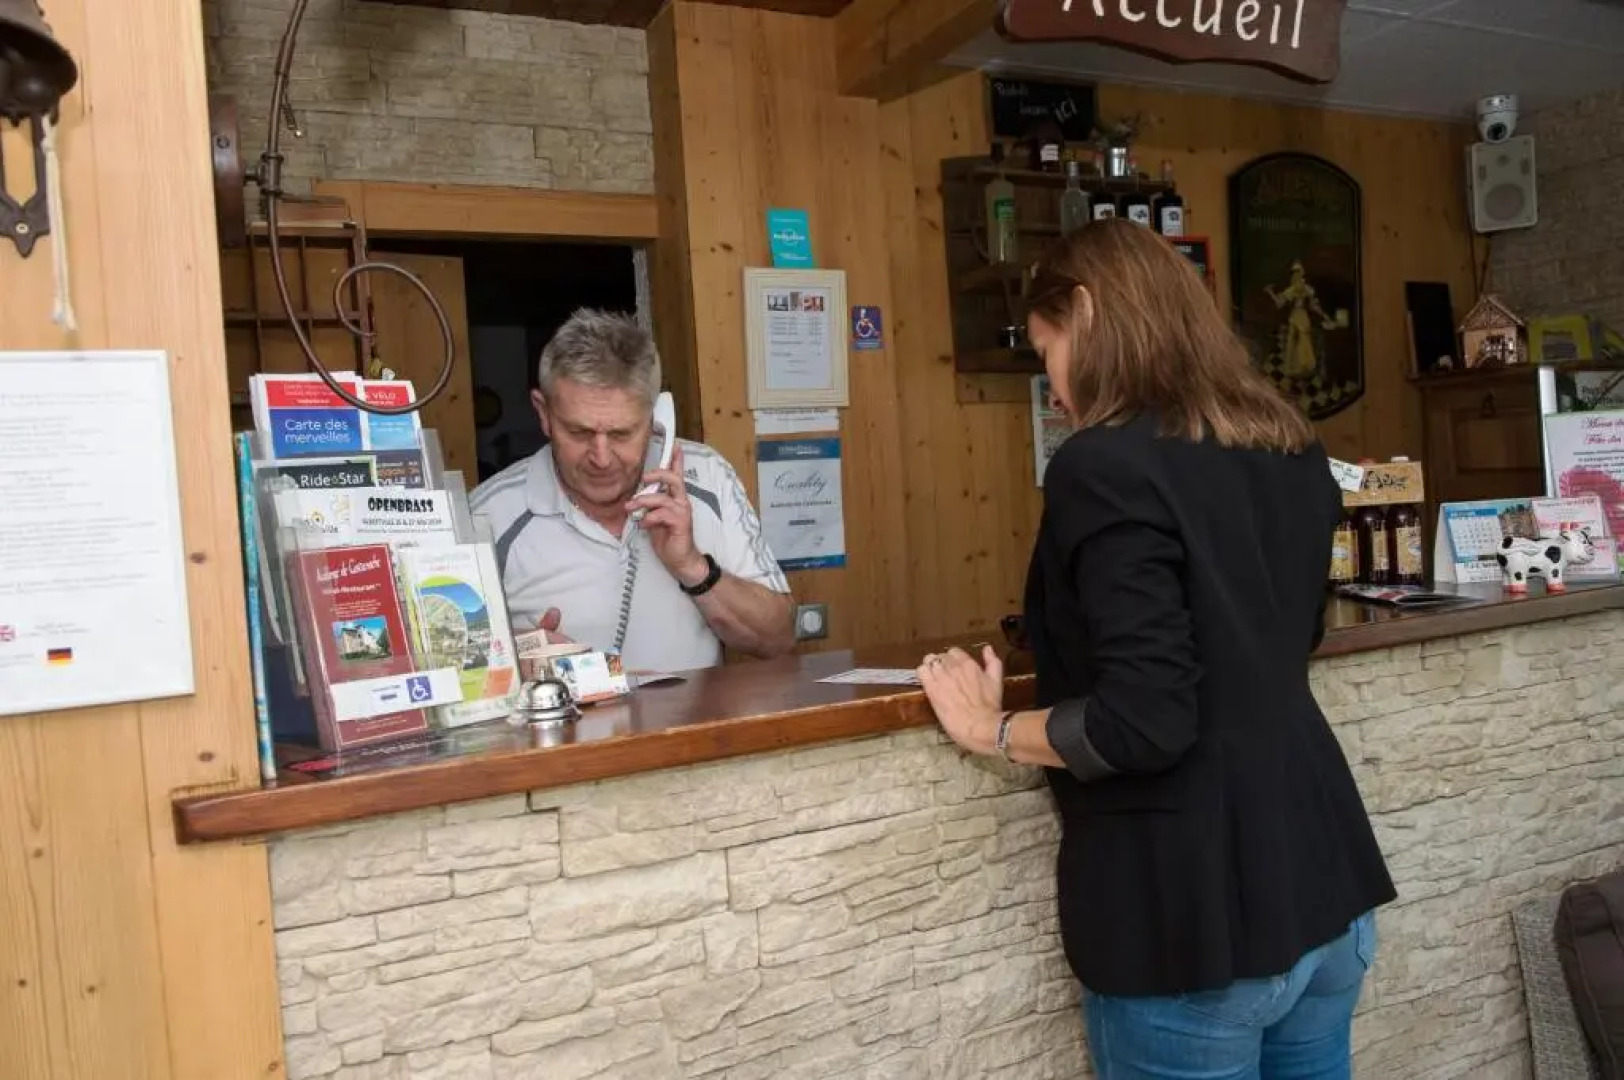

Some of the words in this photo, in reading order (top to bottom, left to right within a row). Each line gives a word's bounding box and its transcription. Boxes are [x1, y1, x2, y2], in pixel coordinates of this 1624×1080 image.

[284, 419, 321, 431] Carte
[325, 419, 349, 431] des
[284, 431, 350, 443] merveilles
[367, 496, 434, 513] OPENBRASS
